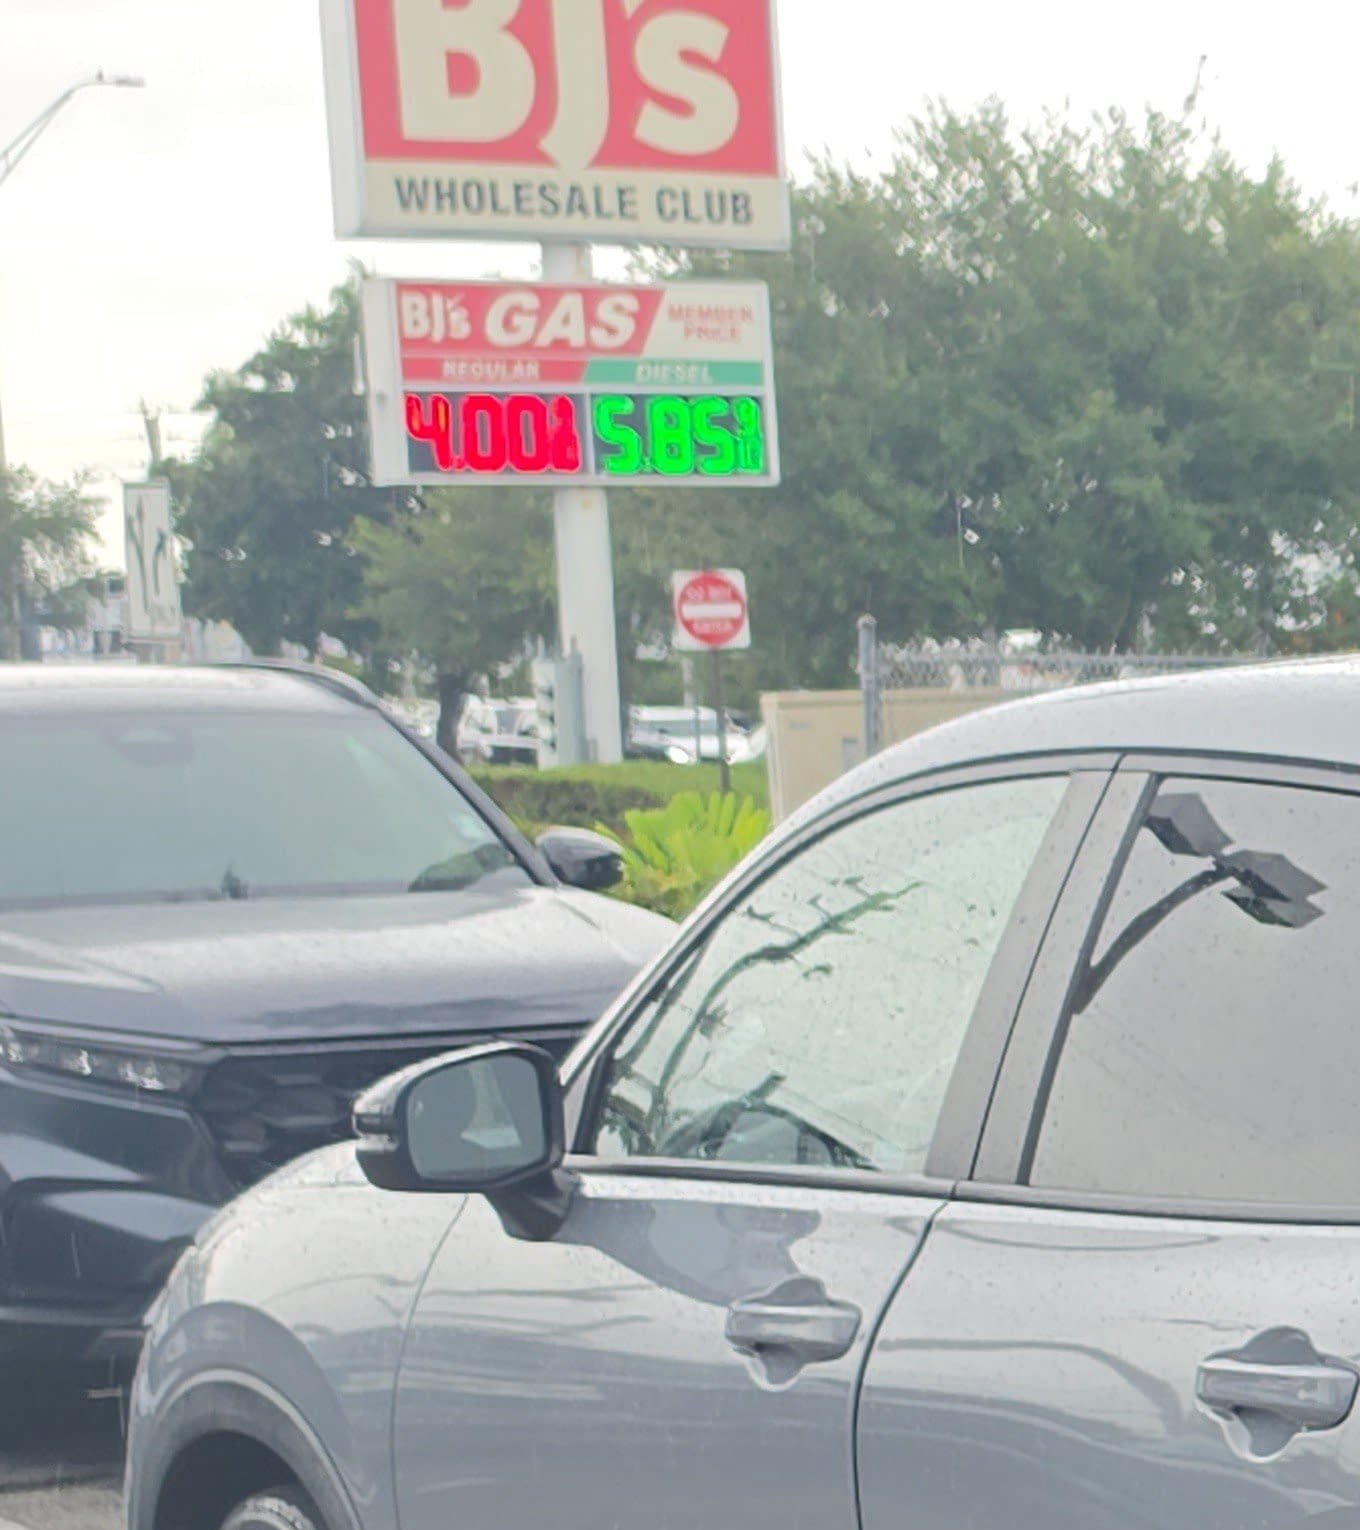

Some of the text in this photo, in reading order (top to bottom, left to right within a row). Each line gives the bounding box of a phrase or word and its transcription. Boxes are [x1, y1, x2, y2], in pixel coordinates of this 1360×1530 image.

[395, 177, 754, 226] WHOLESALE CLUB
[484, 289, 641, 349] GAS
[667, 302, 754, 324] MEMBER
[443, 359, 540, 380] REGULAR
[635, 363, 713, 385] DIESEL
